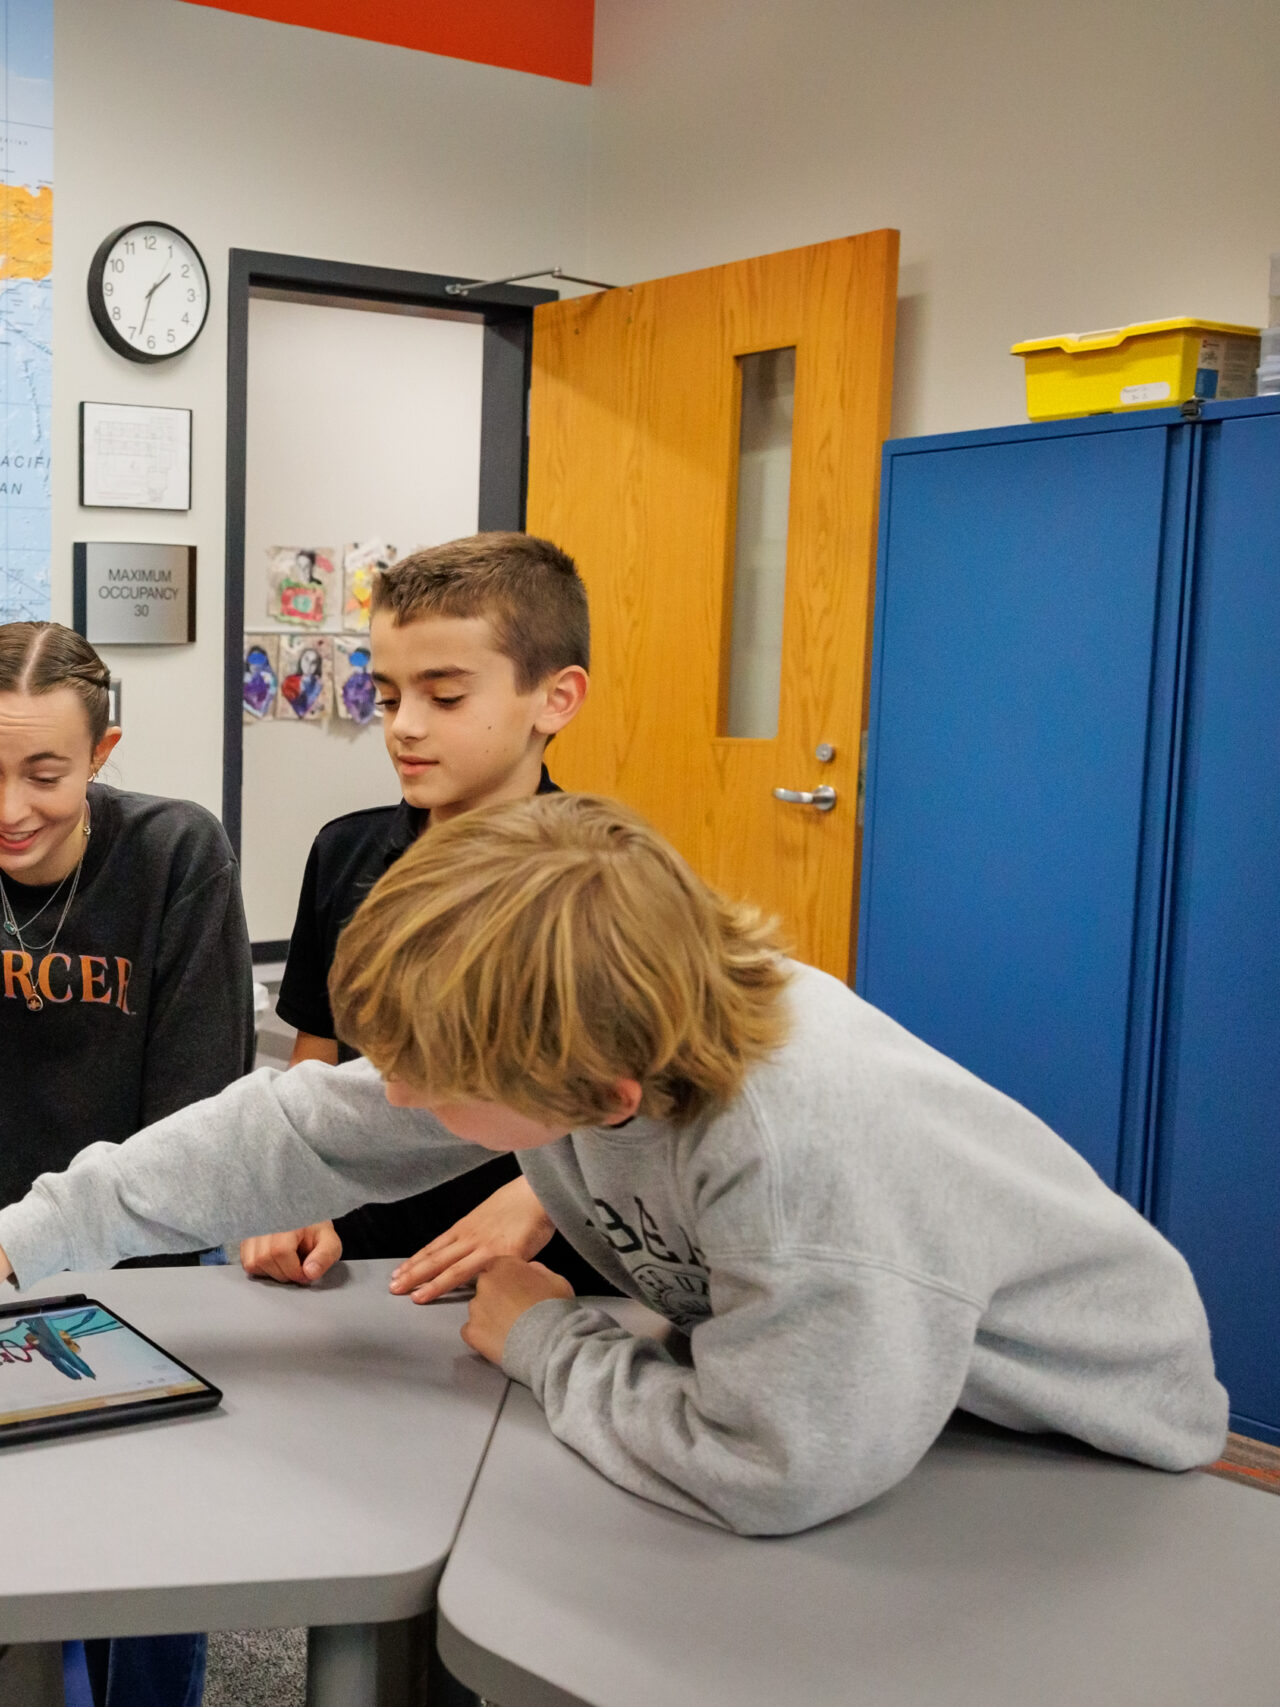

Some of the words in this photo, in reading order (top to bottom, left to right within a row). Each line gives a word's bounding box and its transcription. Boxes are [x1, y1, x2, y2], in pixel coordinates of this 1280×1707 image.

[124, 241, 135, 255] 11
[143, 235, 157, 250] 12
[110, 258, 125, 273] 10
[181, 264, 190, 278] 2
[104, 282, 114, 297] 9
[187, 288, 196, 302] 3
[112, 306, 122, 321] 8
[181, 312, 190, 324] 4
[128, 326, 137, 340] 7
[167, 329, 176, 343] 5
[147, 335, 156, 349] 6
[108, 568, 172, 583] MAXIMUM
[98, 585, 180, 601] OCCUPANCY
[134, 604, 149, 617] 30
